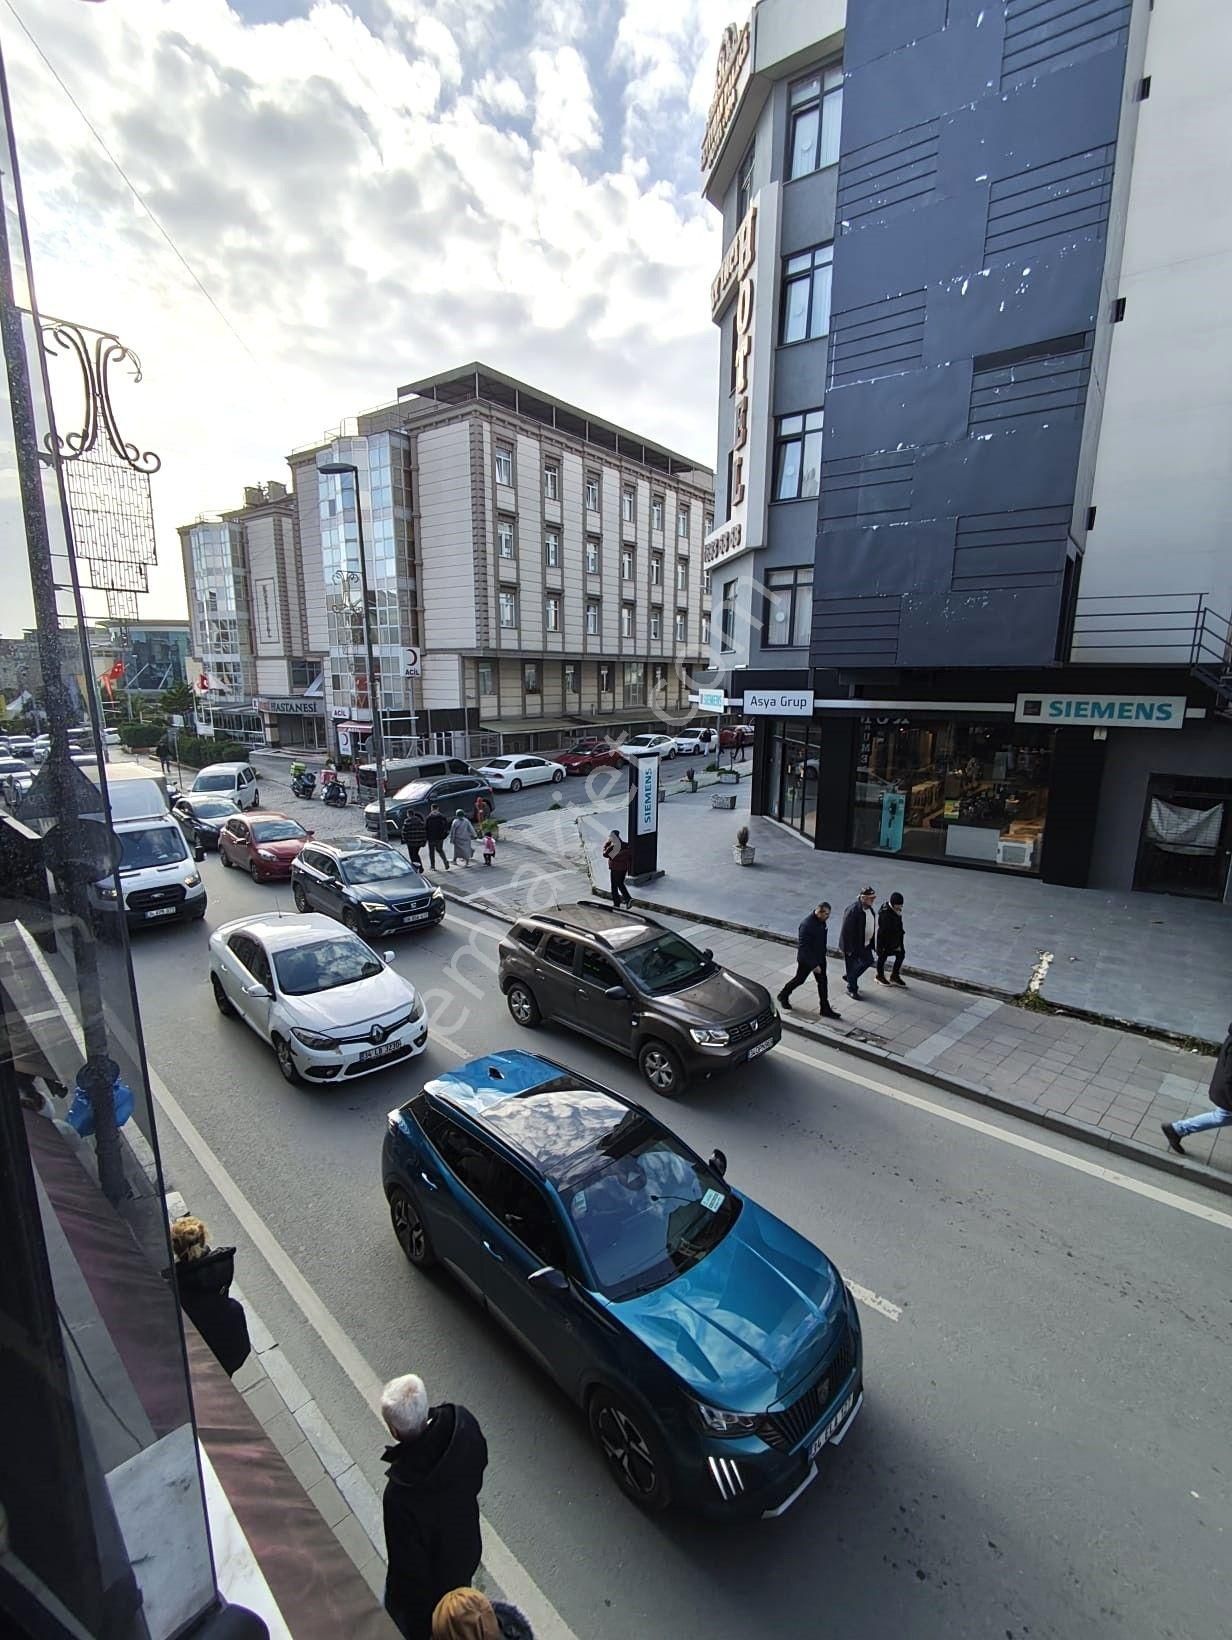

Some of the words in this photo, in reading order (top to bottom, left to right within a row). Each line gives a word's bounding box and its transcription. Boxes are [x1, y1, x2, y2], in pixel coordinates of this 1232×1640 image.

[736, 207, 758, 507] HOTEL
[750, 696, 777, 709] Asya
[780, 695, 807, 709] Grup
[1048, 700, 1173, 721] SIEMENS
[644, 768, 652, 824] SIEMENS
